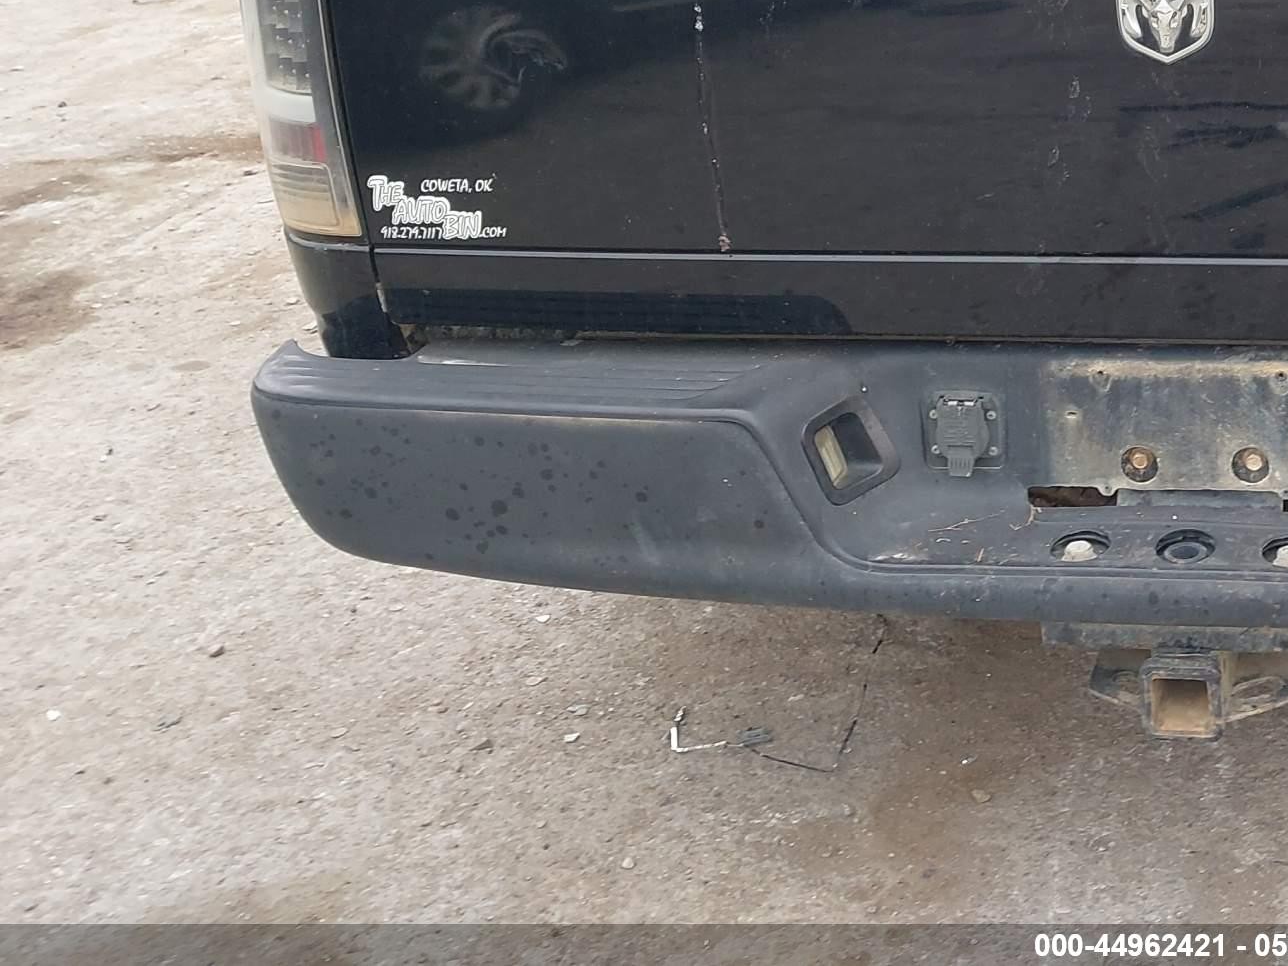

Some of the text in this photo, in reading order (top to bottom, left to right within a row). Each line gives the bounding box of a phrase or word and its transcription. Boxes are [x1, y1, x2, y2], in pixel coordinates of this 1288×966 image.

[420, 179, 493, 193] COWETA, OK
[392, 195, 450, 225] AUTO
